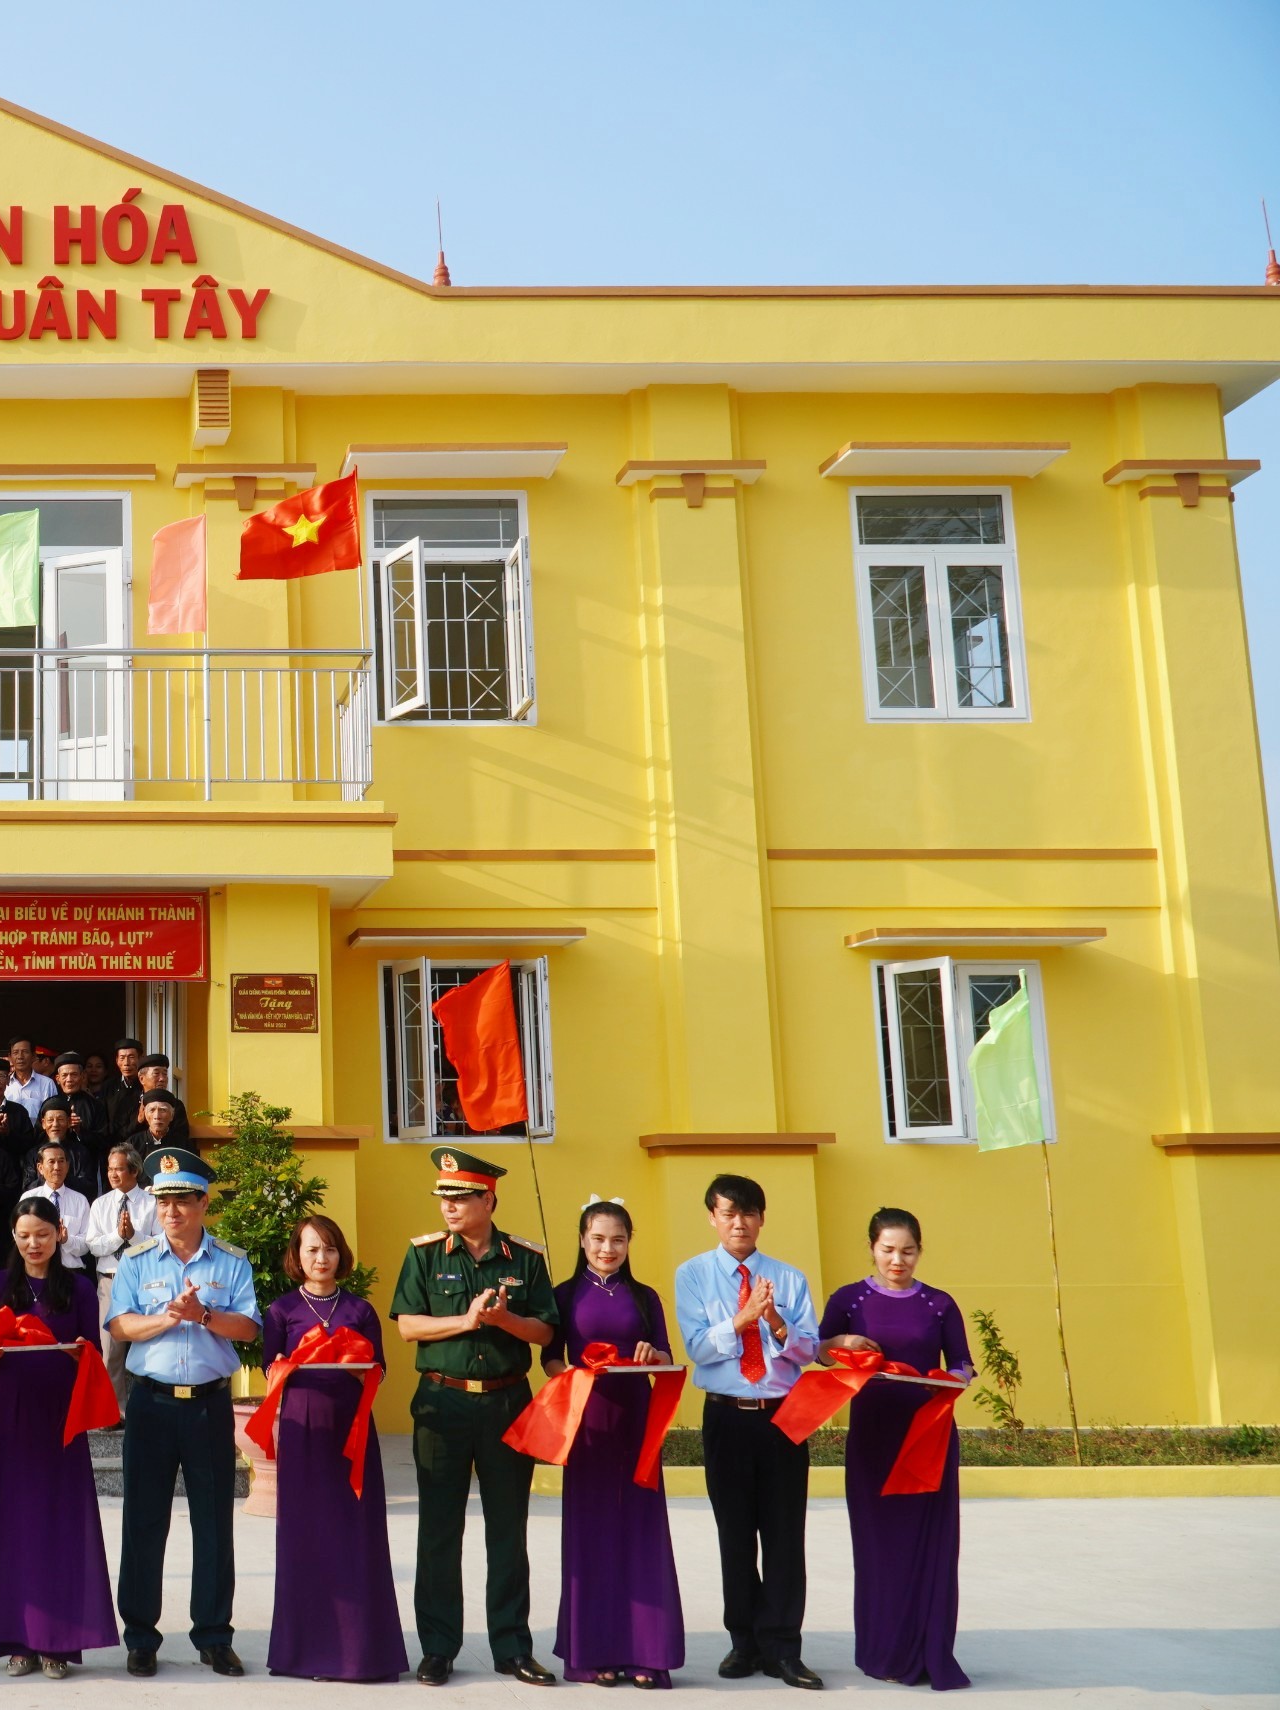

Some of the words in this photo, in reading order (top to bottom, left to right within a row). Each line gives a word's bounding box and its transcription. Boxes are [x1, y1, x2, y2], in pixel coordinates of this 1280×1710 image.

[53, 187, 198, 265] HÓA
[141, 274, 271, 340] TÂY
[14, 900, 47, 921] BIỂU
[51, 901, 69, 921] VỀ
[73, 904, 94, 924] DỰ
[97, 903, 145, 921] KHÁNH
[149, 903, 195, 921] THÀNH
[0, 929, 27, 948] HỢP
[31, 927, 77, 945] TRÁNH
[82, 927, 115, 948] BÃO,
[22, 951, 55, 970] TỈNH
[59, 952, 97, 970] THỪA
[100, 952, 143, 970] THIÊN
[146, 950, 177, 970] HUẾ
[259, 997, 292, 1010] Tặng
